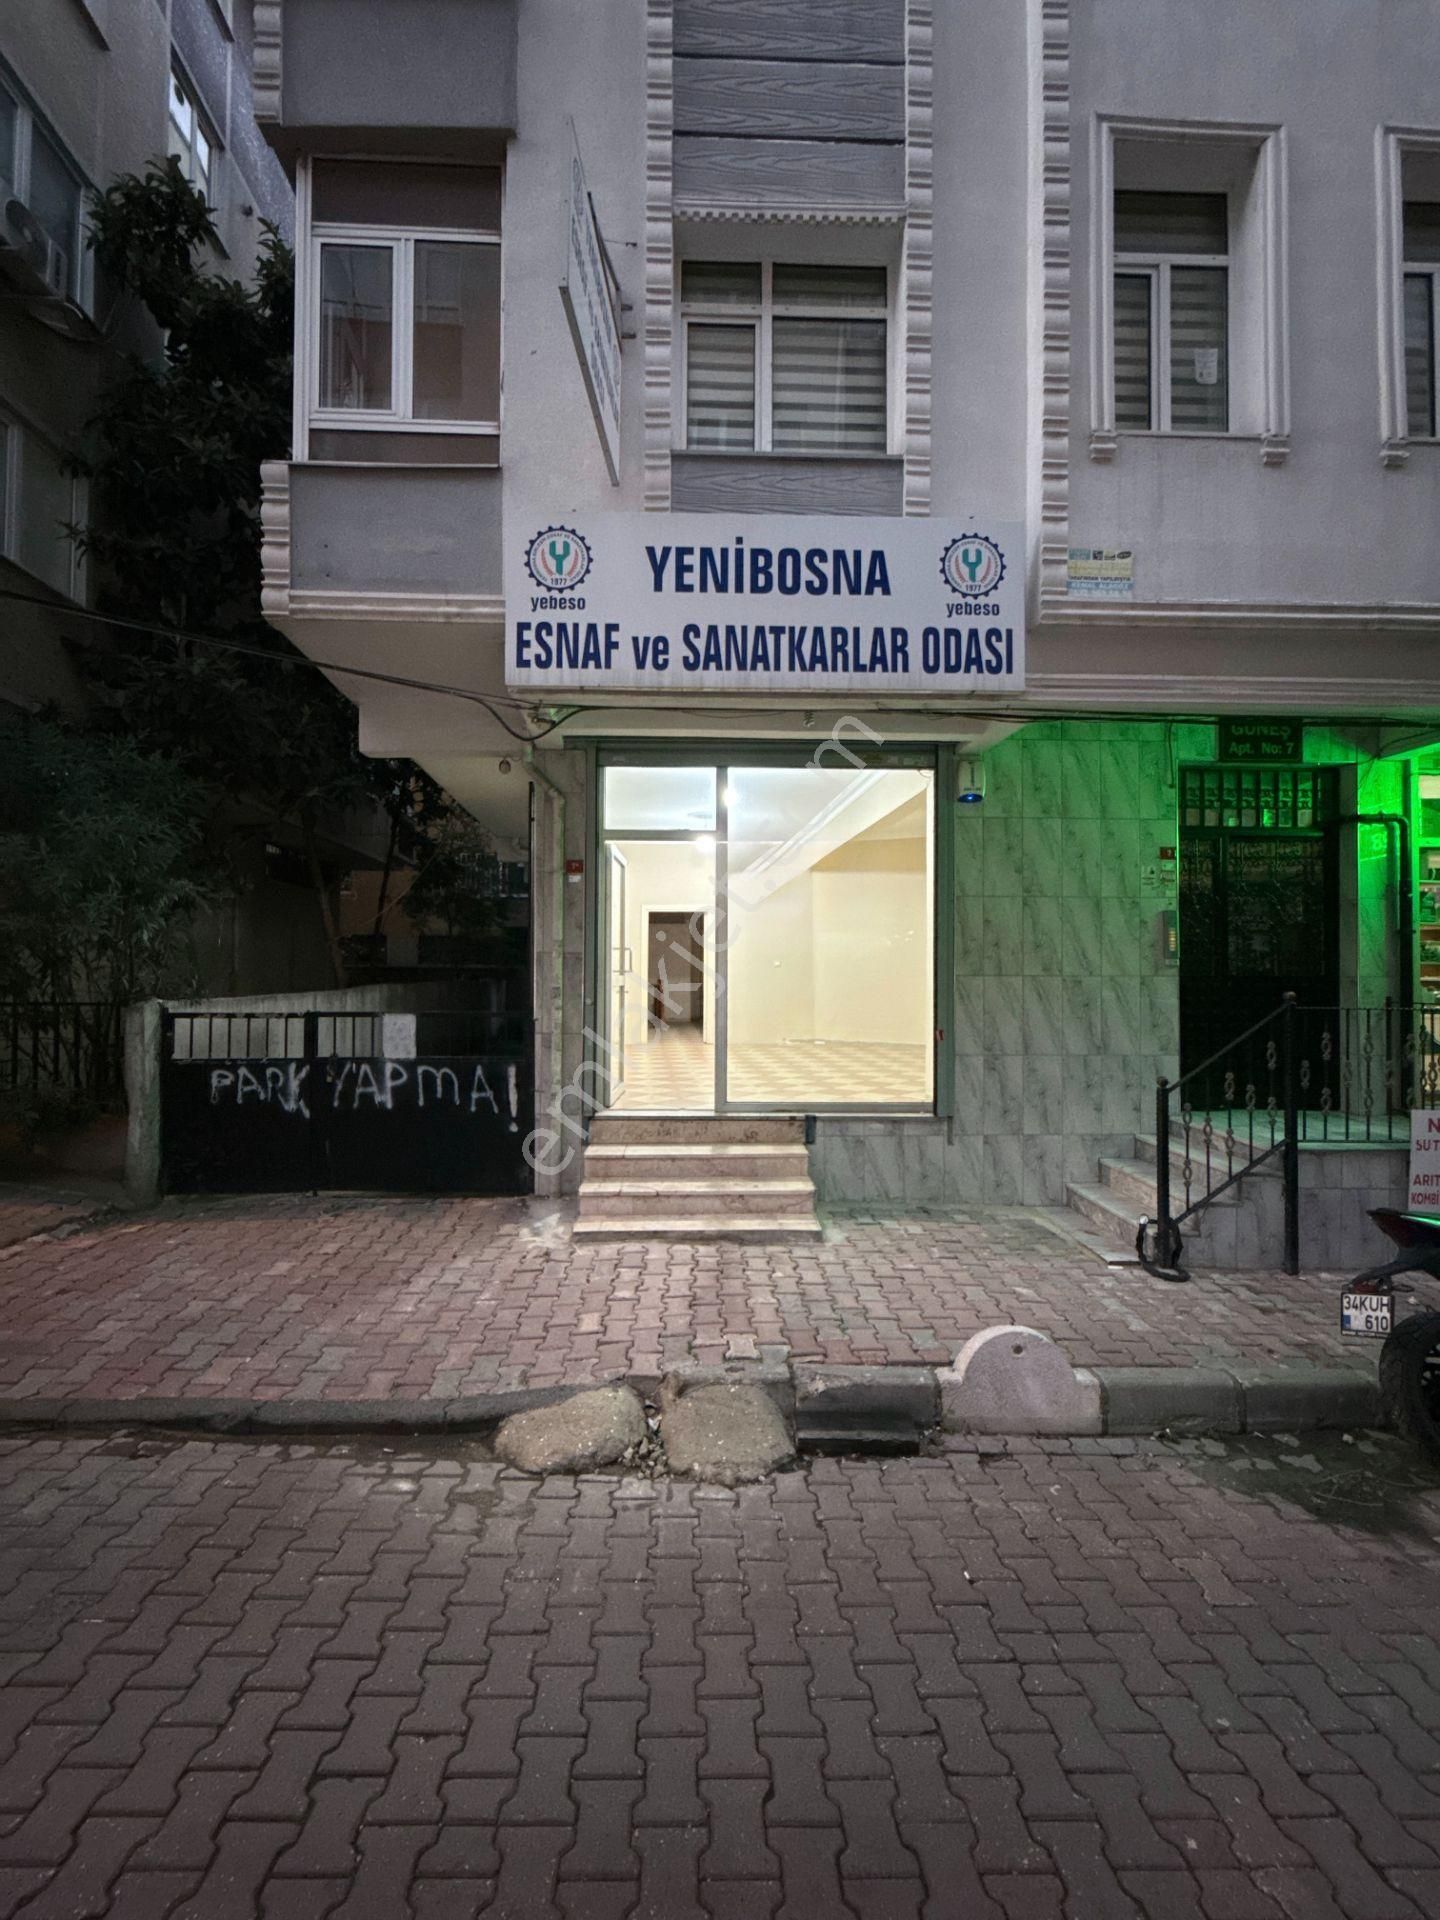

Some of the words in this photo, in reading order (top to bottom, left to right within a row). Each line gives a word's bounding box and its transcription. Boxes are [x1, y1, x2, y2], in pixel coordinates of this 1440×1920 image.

[645, 536, 892, 596] YENİBOSNA
[531, 595, 586, 612] yebeso
[946, 602, 1000, 618] yebeso
[515, 620, 620, 670] ESNAF
[632, 635, 669, 670] ve
[682, 624, 909, 674] SANATKARLAR
[922, 627, 1014, 676] ODASI
[1229, 742, 1255, 756] Apt.
[1286, 742, 1295, 755] 7
[210, 1062, 311, 1119] PARK
[1365, 1314, 1389, 1331] 610
